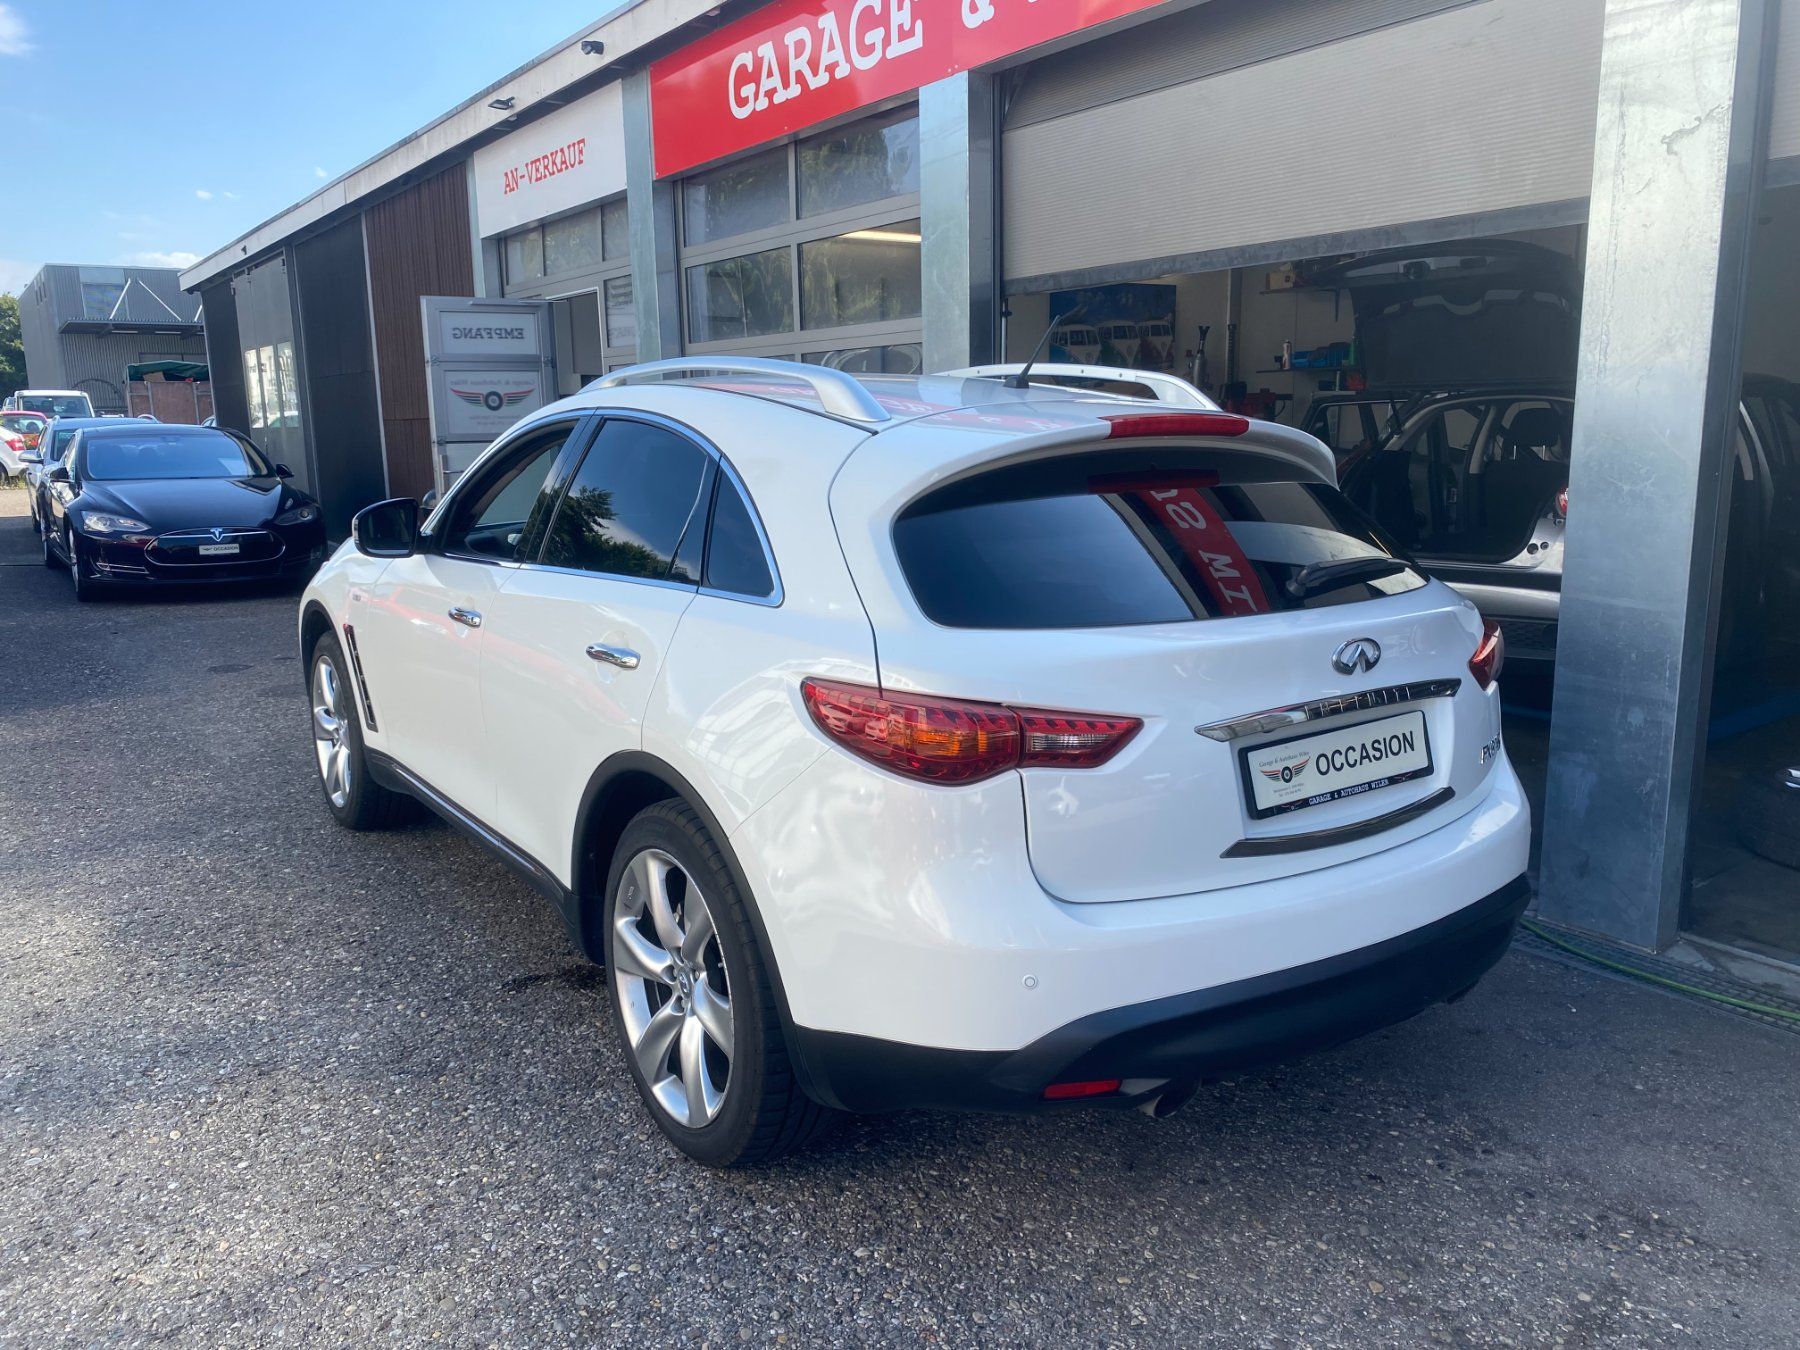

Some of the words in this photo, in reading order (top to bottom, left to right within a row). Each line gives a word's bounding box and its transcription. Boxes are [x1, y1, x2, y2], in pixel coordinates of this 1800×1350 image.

[728, 0, 923, 120] GARAGE
[504, 138, 586, 195] AN-VERKAUF
[1315, 730, 1415, 776] OCCASION
[1309, 793, 1332, 806] GARAGE
[1370, 778, 1390, 789] WILER
